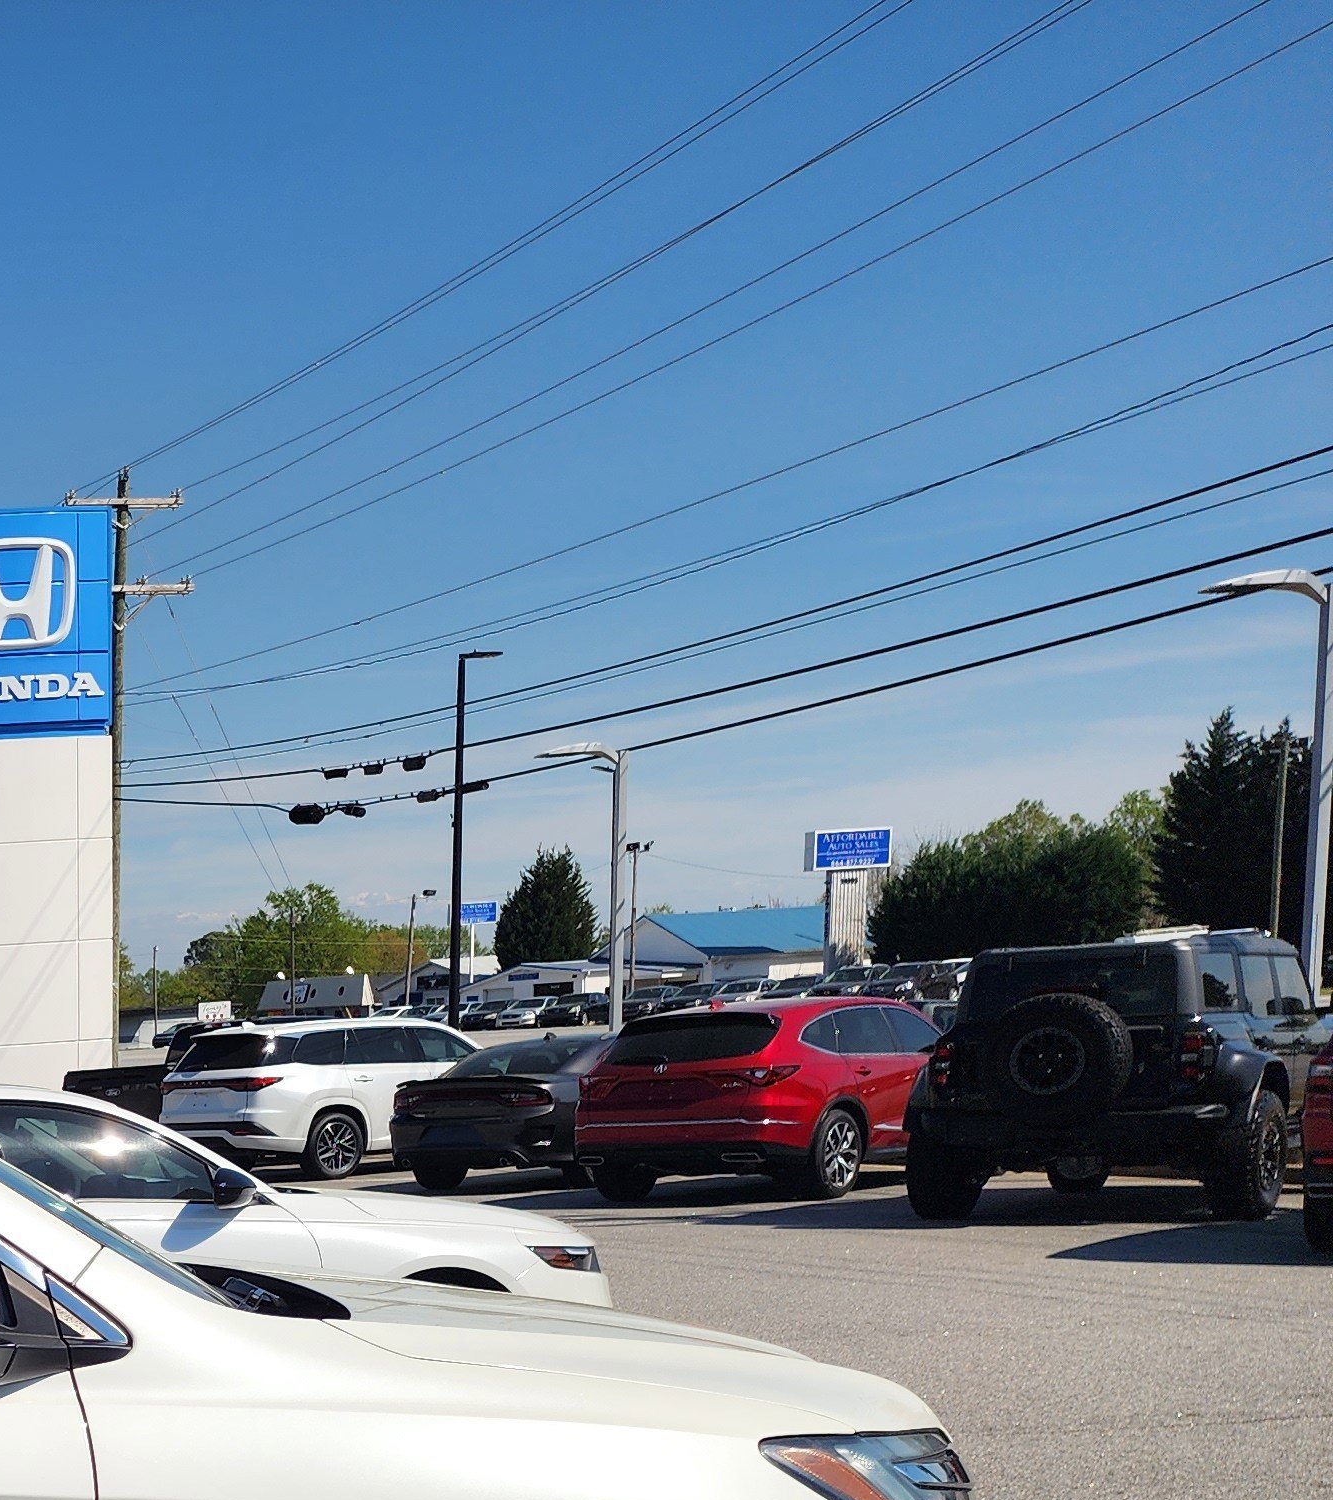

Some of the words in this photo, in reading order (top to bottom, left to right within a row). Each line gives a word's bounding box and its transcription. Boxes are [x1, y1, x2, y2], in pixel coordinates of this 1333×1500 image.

[822, 831, 885, 844] AFFORDABLE
[827, 842, 852, 854] AUTO
[854, 840, 879, 850] SALES
